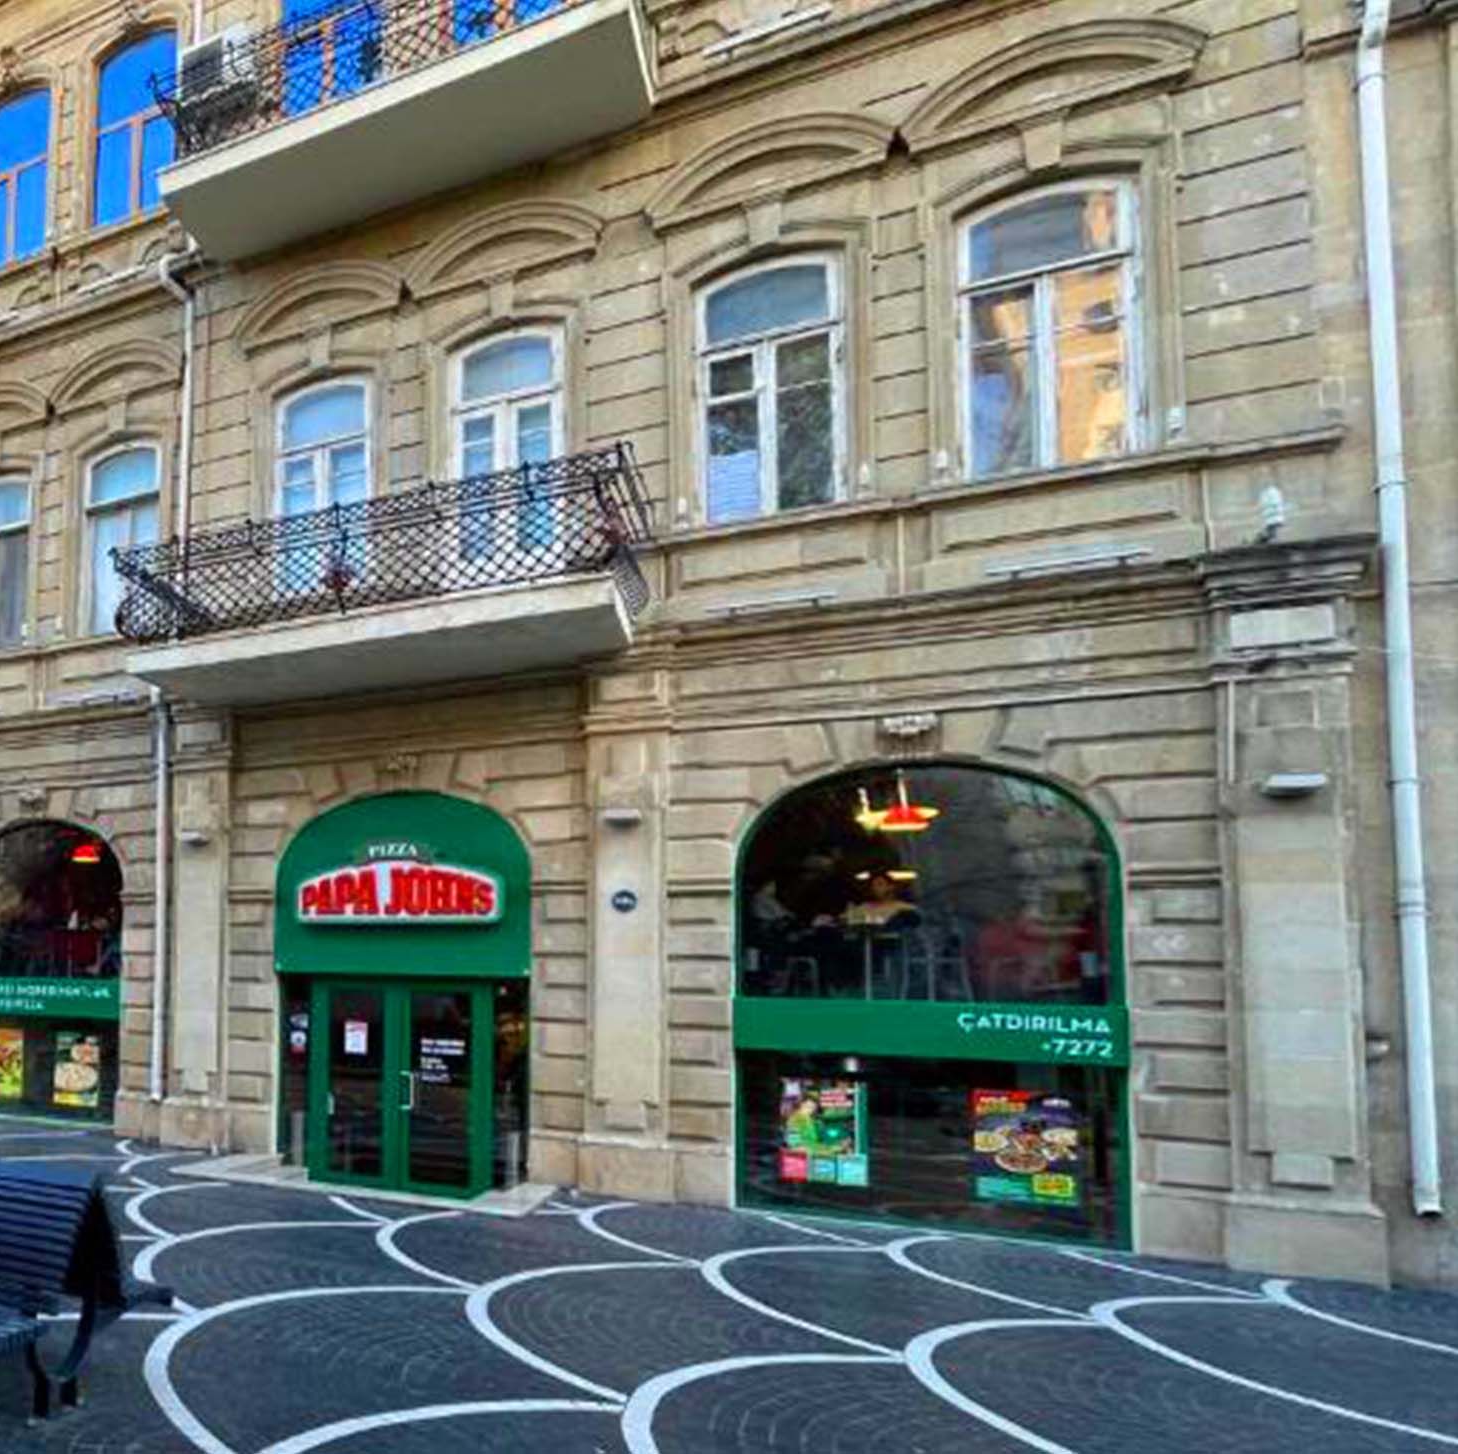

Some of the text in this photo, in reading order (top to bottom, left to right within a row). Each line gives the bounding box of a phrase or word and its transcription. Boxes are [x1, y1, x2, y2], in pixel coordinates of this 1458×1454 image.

[368, 842, 418, 858] PIZZA
[301, 866, 379, 915] PAPA
[957, 1012, 1111, 1034] ÇATDIRILMA
